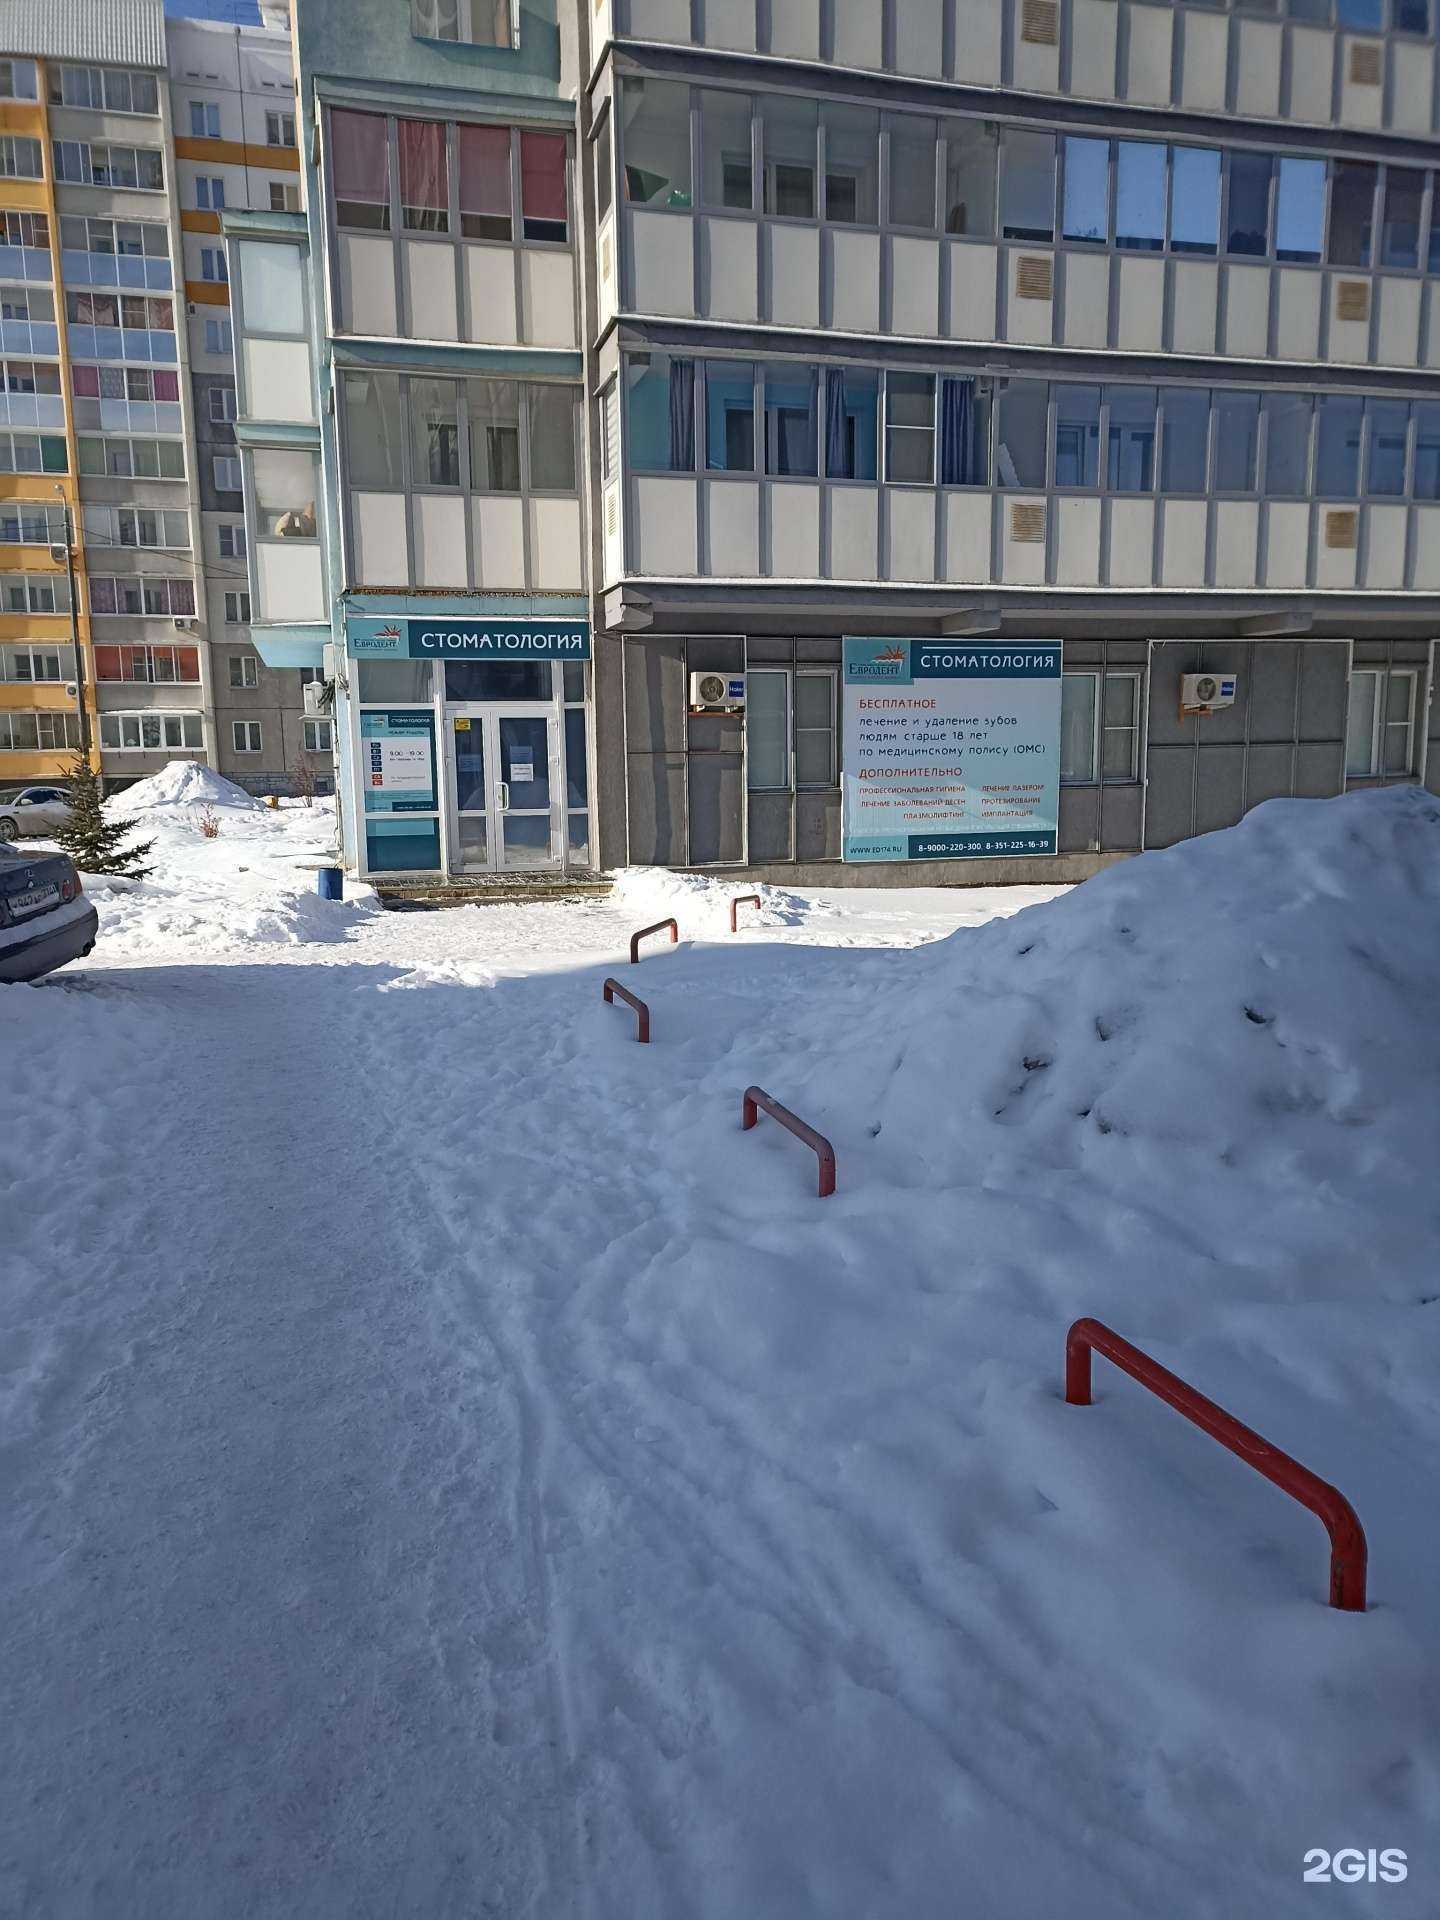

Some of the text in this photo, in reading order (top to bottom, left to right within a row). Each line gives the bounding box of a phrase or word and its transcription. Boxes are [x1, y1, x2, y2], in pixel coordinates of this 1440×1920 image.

[421, 632, 582, 649] СТОМАТОЛОГИЯ
[921, 655, 1054, 668] СТОМАТОЛОГИЯ
[859, 699, 936, 709] БЕСПЛАТНОЕ
[859, 716, 1017, 728] лечение и удаление зубов
[859, 733, 897, 742] людям
[904, 732, 947, 743] старше
[953, 732, 963, 740] 18
[859, 745, 1046, 757] по медицинскому полису (ОМС)
[859, 768, 962, 779] ДОПОЛНИТЕЛЬНО
[859, 786, 934, 794] ПРОФЕССИОНАЛЬНАЯ
[894, 798, 943, 807] ЗАБОЛЕВАНИЙ
[982, 797, 1040, 805] ПРОТЕЗИРОВАНИЕ
[982, 810, 1033, 818] ИМПЛАНТАЦИЯ
[918, 840, 1049, 851] 8-9000-220-300 8-351-225-16-39
